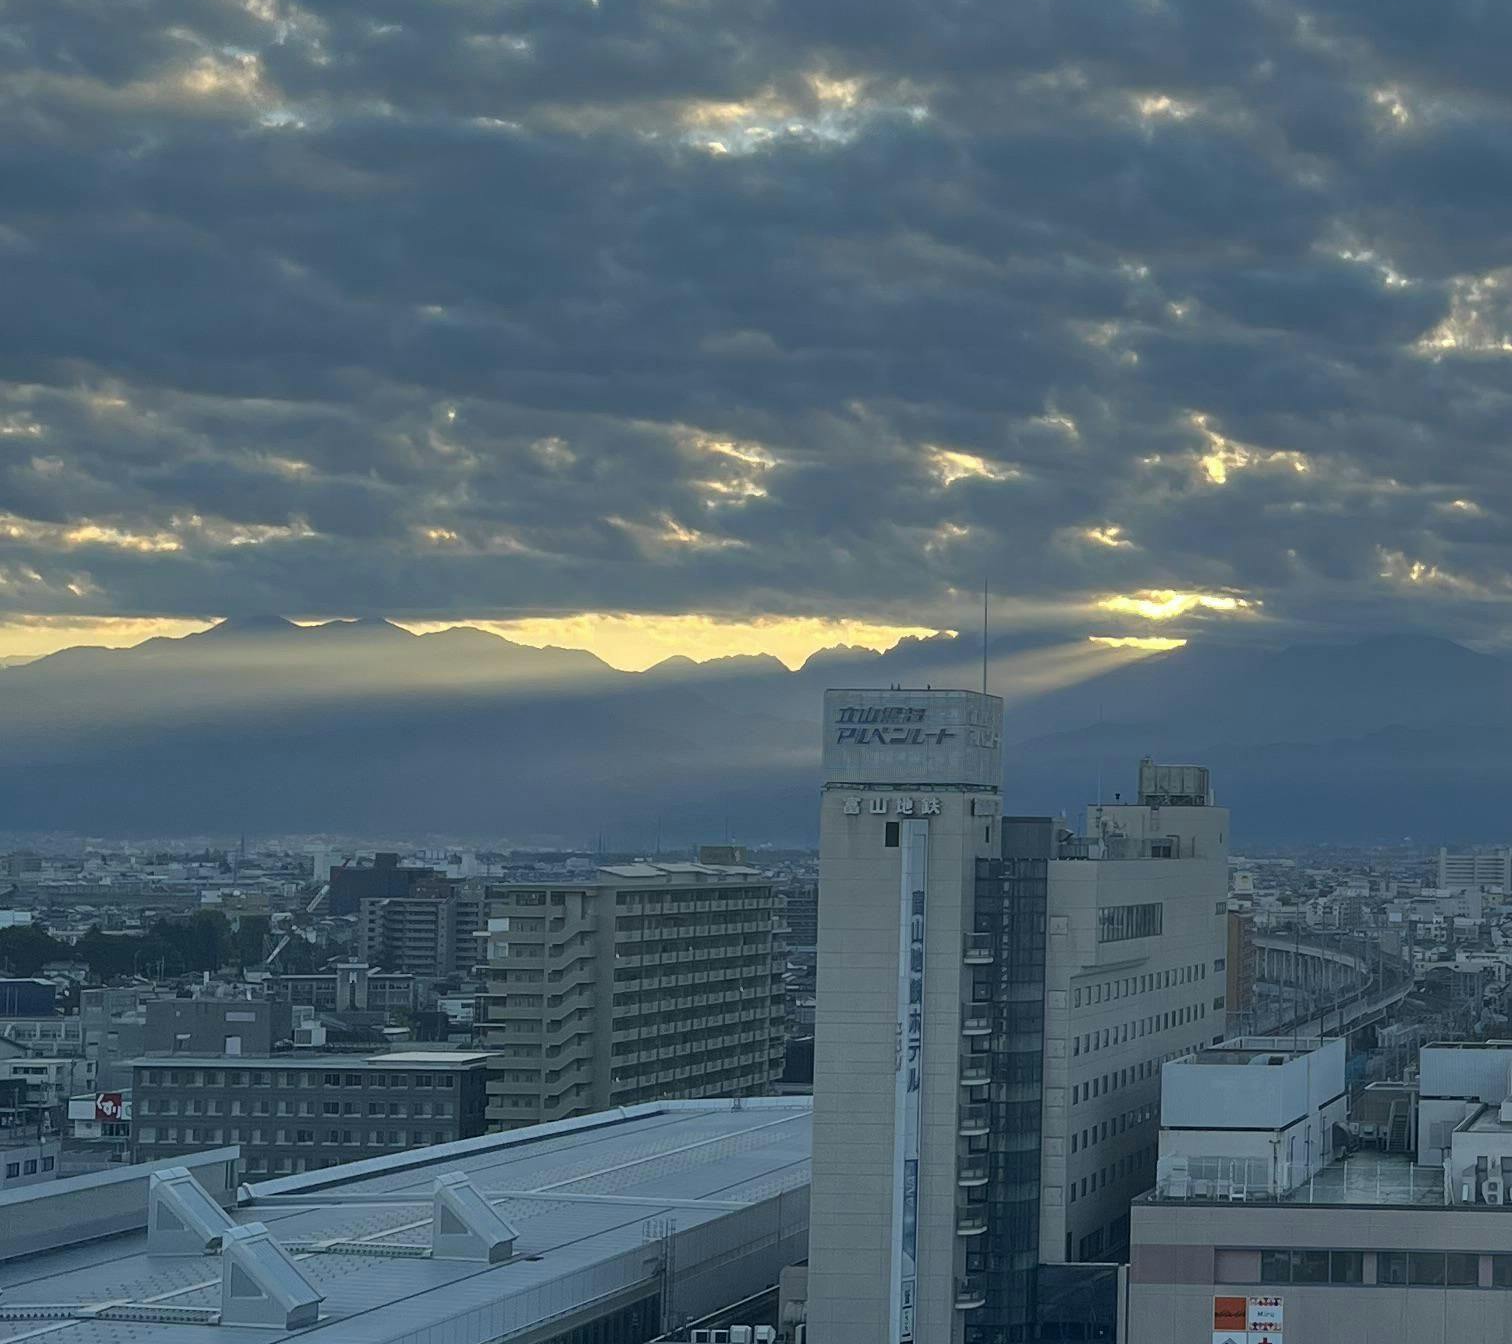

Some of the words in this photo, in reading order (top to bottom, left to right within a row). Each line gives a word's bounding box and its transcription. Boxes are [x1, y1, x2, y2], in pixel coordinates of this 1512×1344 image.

[837, 727, 955, 745] アルペンルート
[844, 798, 941, 815] 富山地鉄
